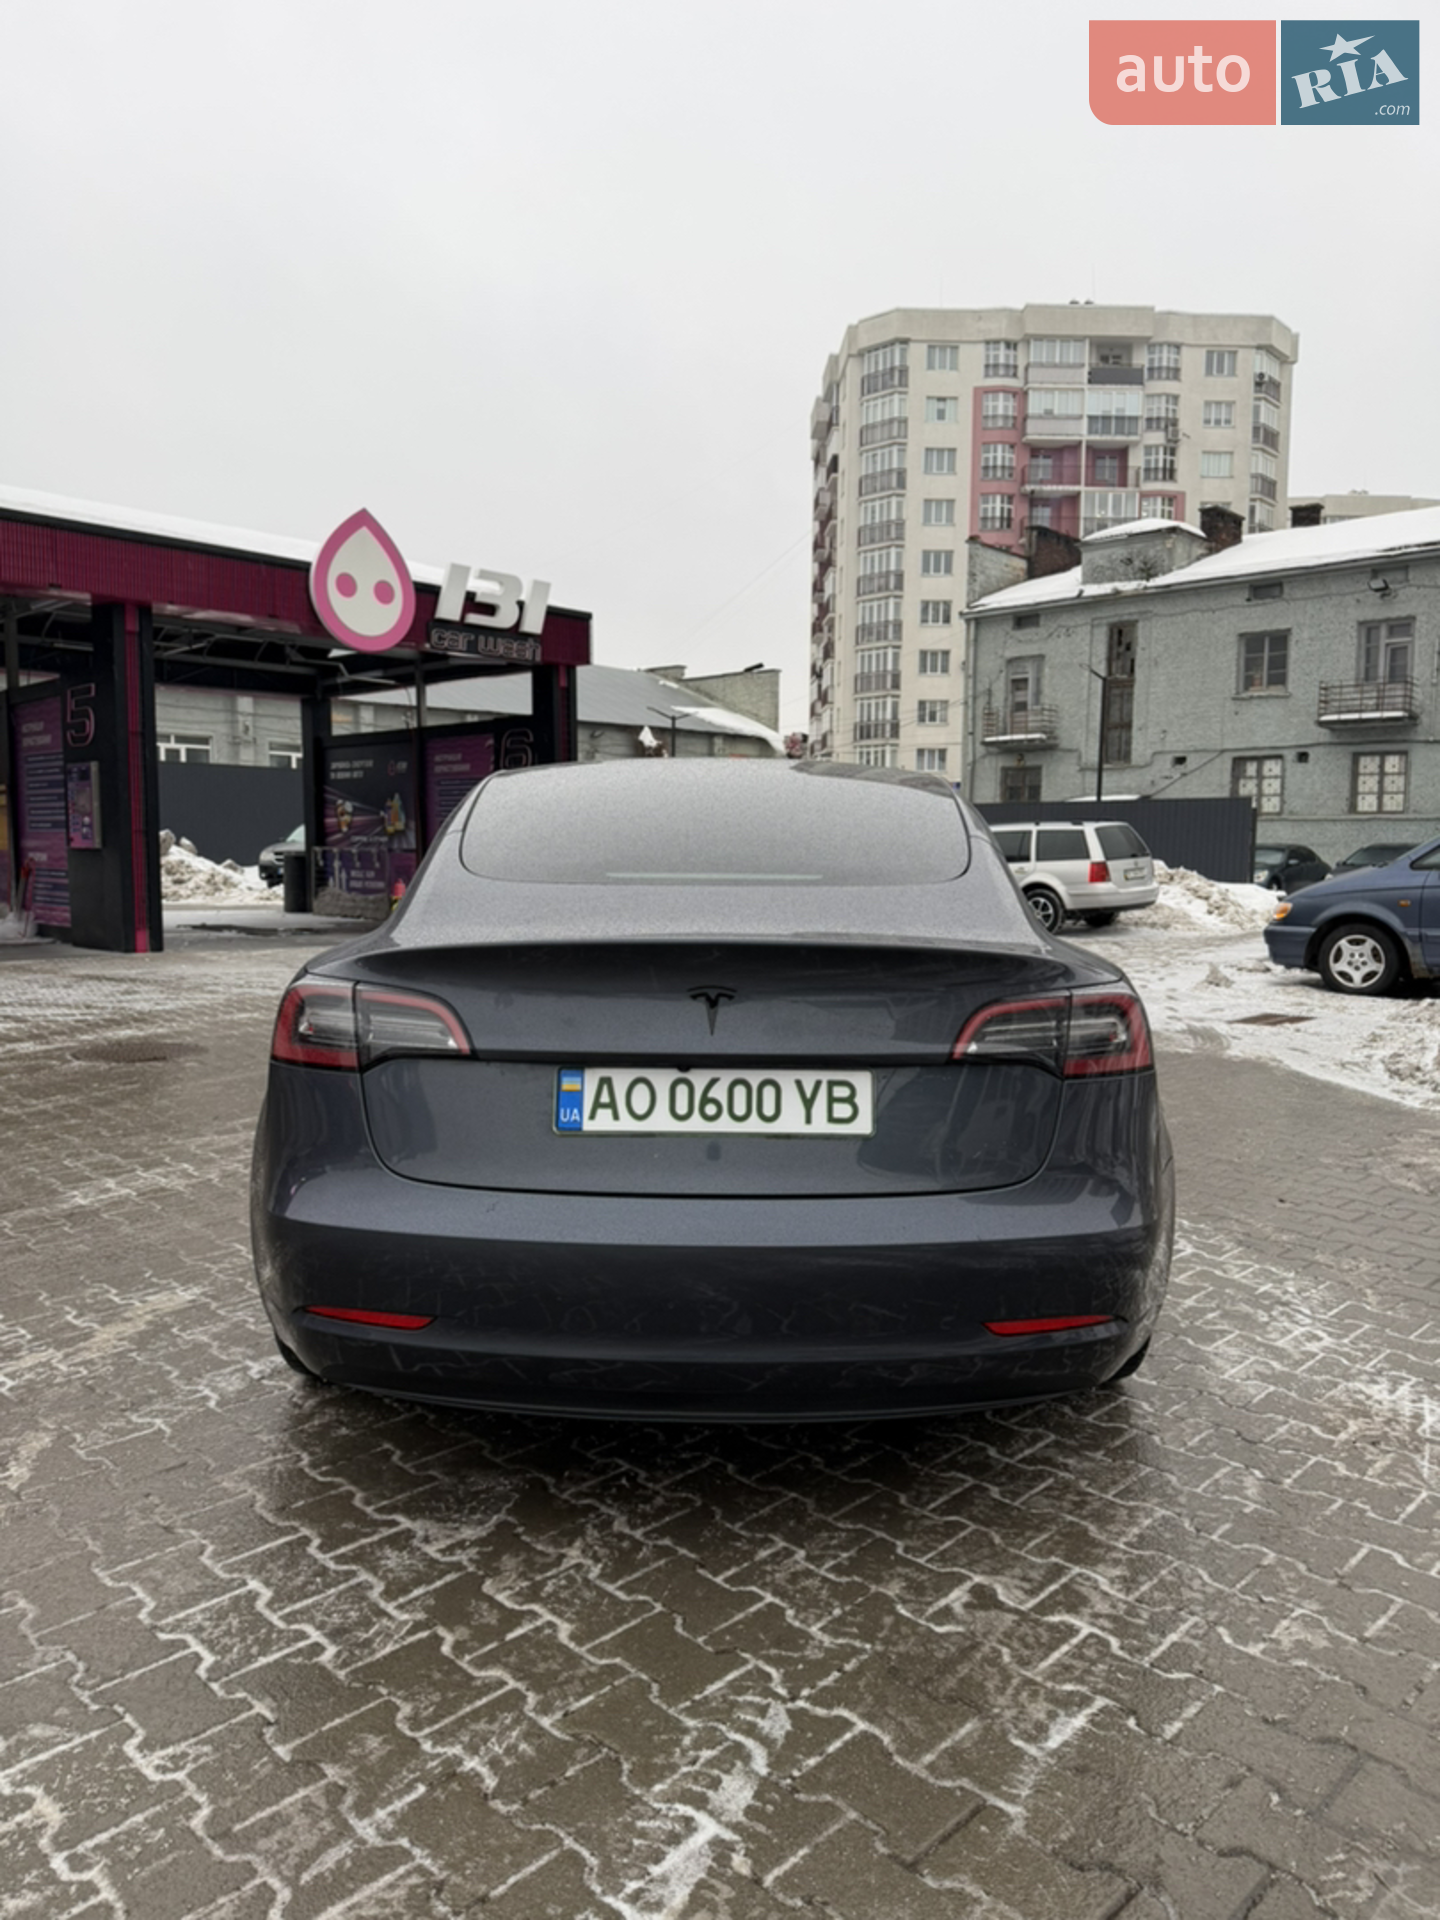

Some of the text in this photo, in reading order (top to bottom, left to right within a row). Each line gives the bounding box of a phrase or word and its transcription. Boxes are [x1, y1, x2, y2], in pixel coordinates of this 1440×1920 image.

[430, 628, 543, 662] car wash
[66, 682, 97, 748] 5
[500, 727, 534, 769] 6
[560, 1108, 581, 1123] UA
[588, 1076, 860, 1125] AO 0600 YB
